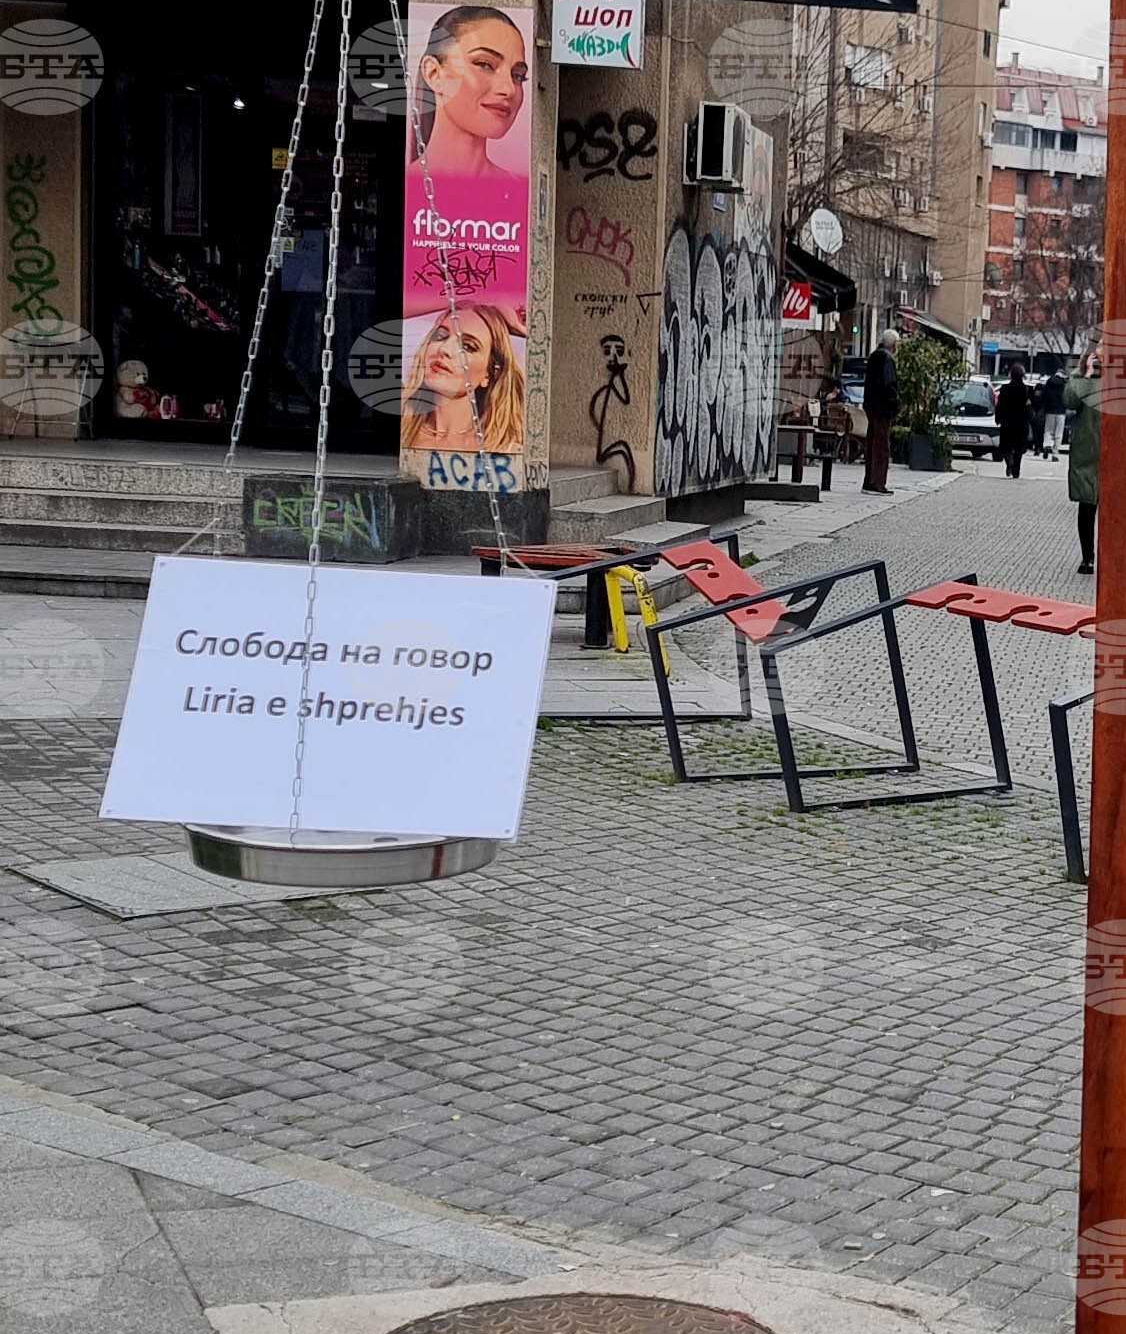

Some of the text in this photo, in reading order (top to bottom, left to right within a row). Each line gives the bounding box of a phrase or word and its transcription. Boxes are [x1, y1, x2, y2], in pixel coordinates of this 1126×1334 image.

[575, 6, 632, 28] ШОП
[413, 208, 521, 240] flormar
[783, 287, 809, 317] lly
[429, 451, 518, 495] ACAB
[175, 629, 328, 666] Слобода
[340, 644, 381, 665] на
[393, 646, 494, 677] говор
[184, 685, 466, 730] Liria e shprehjes
